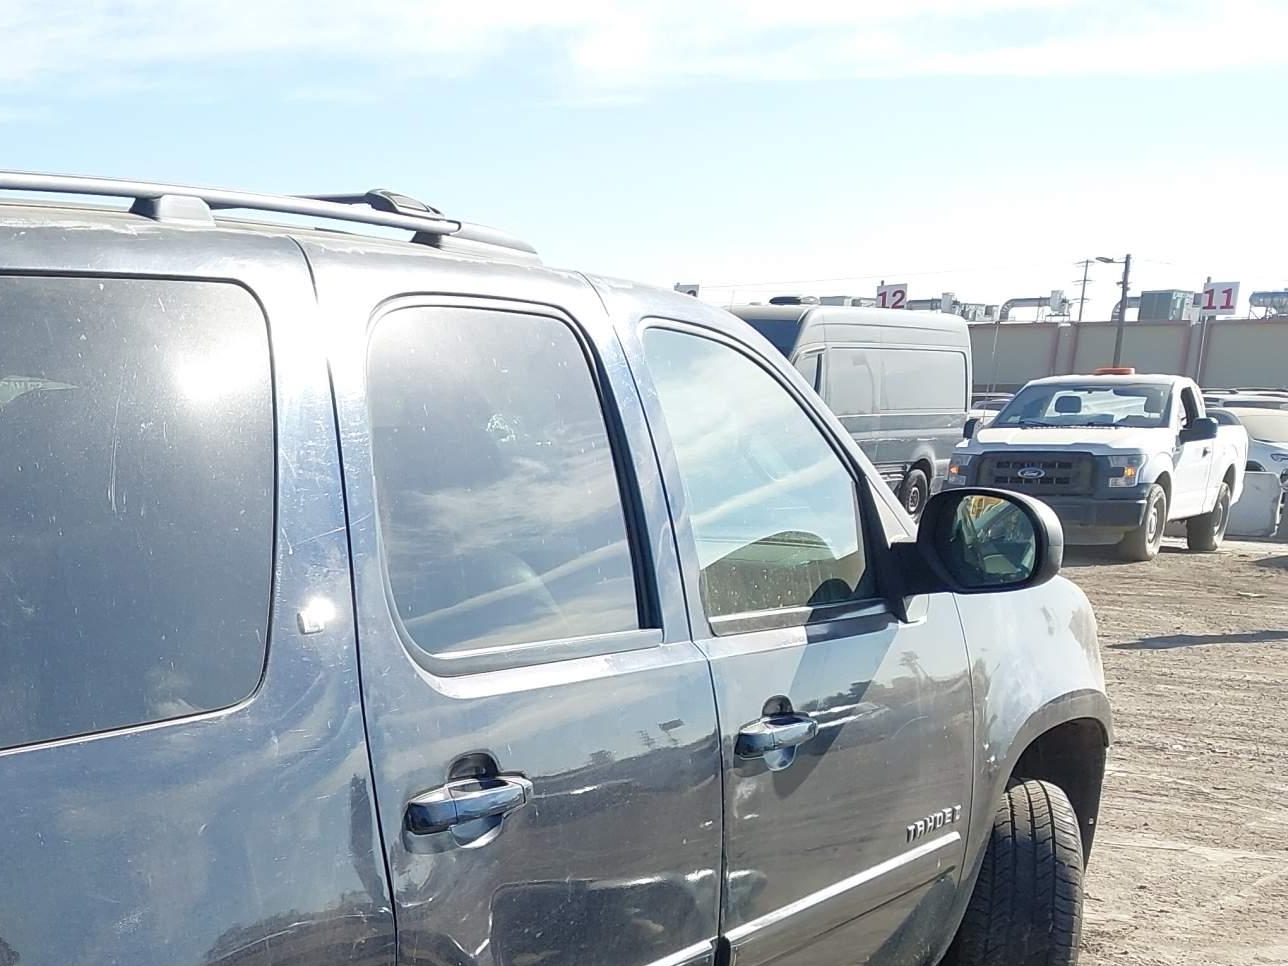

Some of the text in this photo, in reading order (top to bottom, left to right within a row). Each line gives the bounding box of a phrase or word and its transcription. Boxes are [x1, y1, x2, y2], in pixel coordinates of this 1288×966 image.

[878, 290, 905, 309] 12
[1202, 288, 1234, 310] 11
[907, 807, 953, 842] TAHOE
